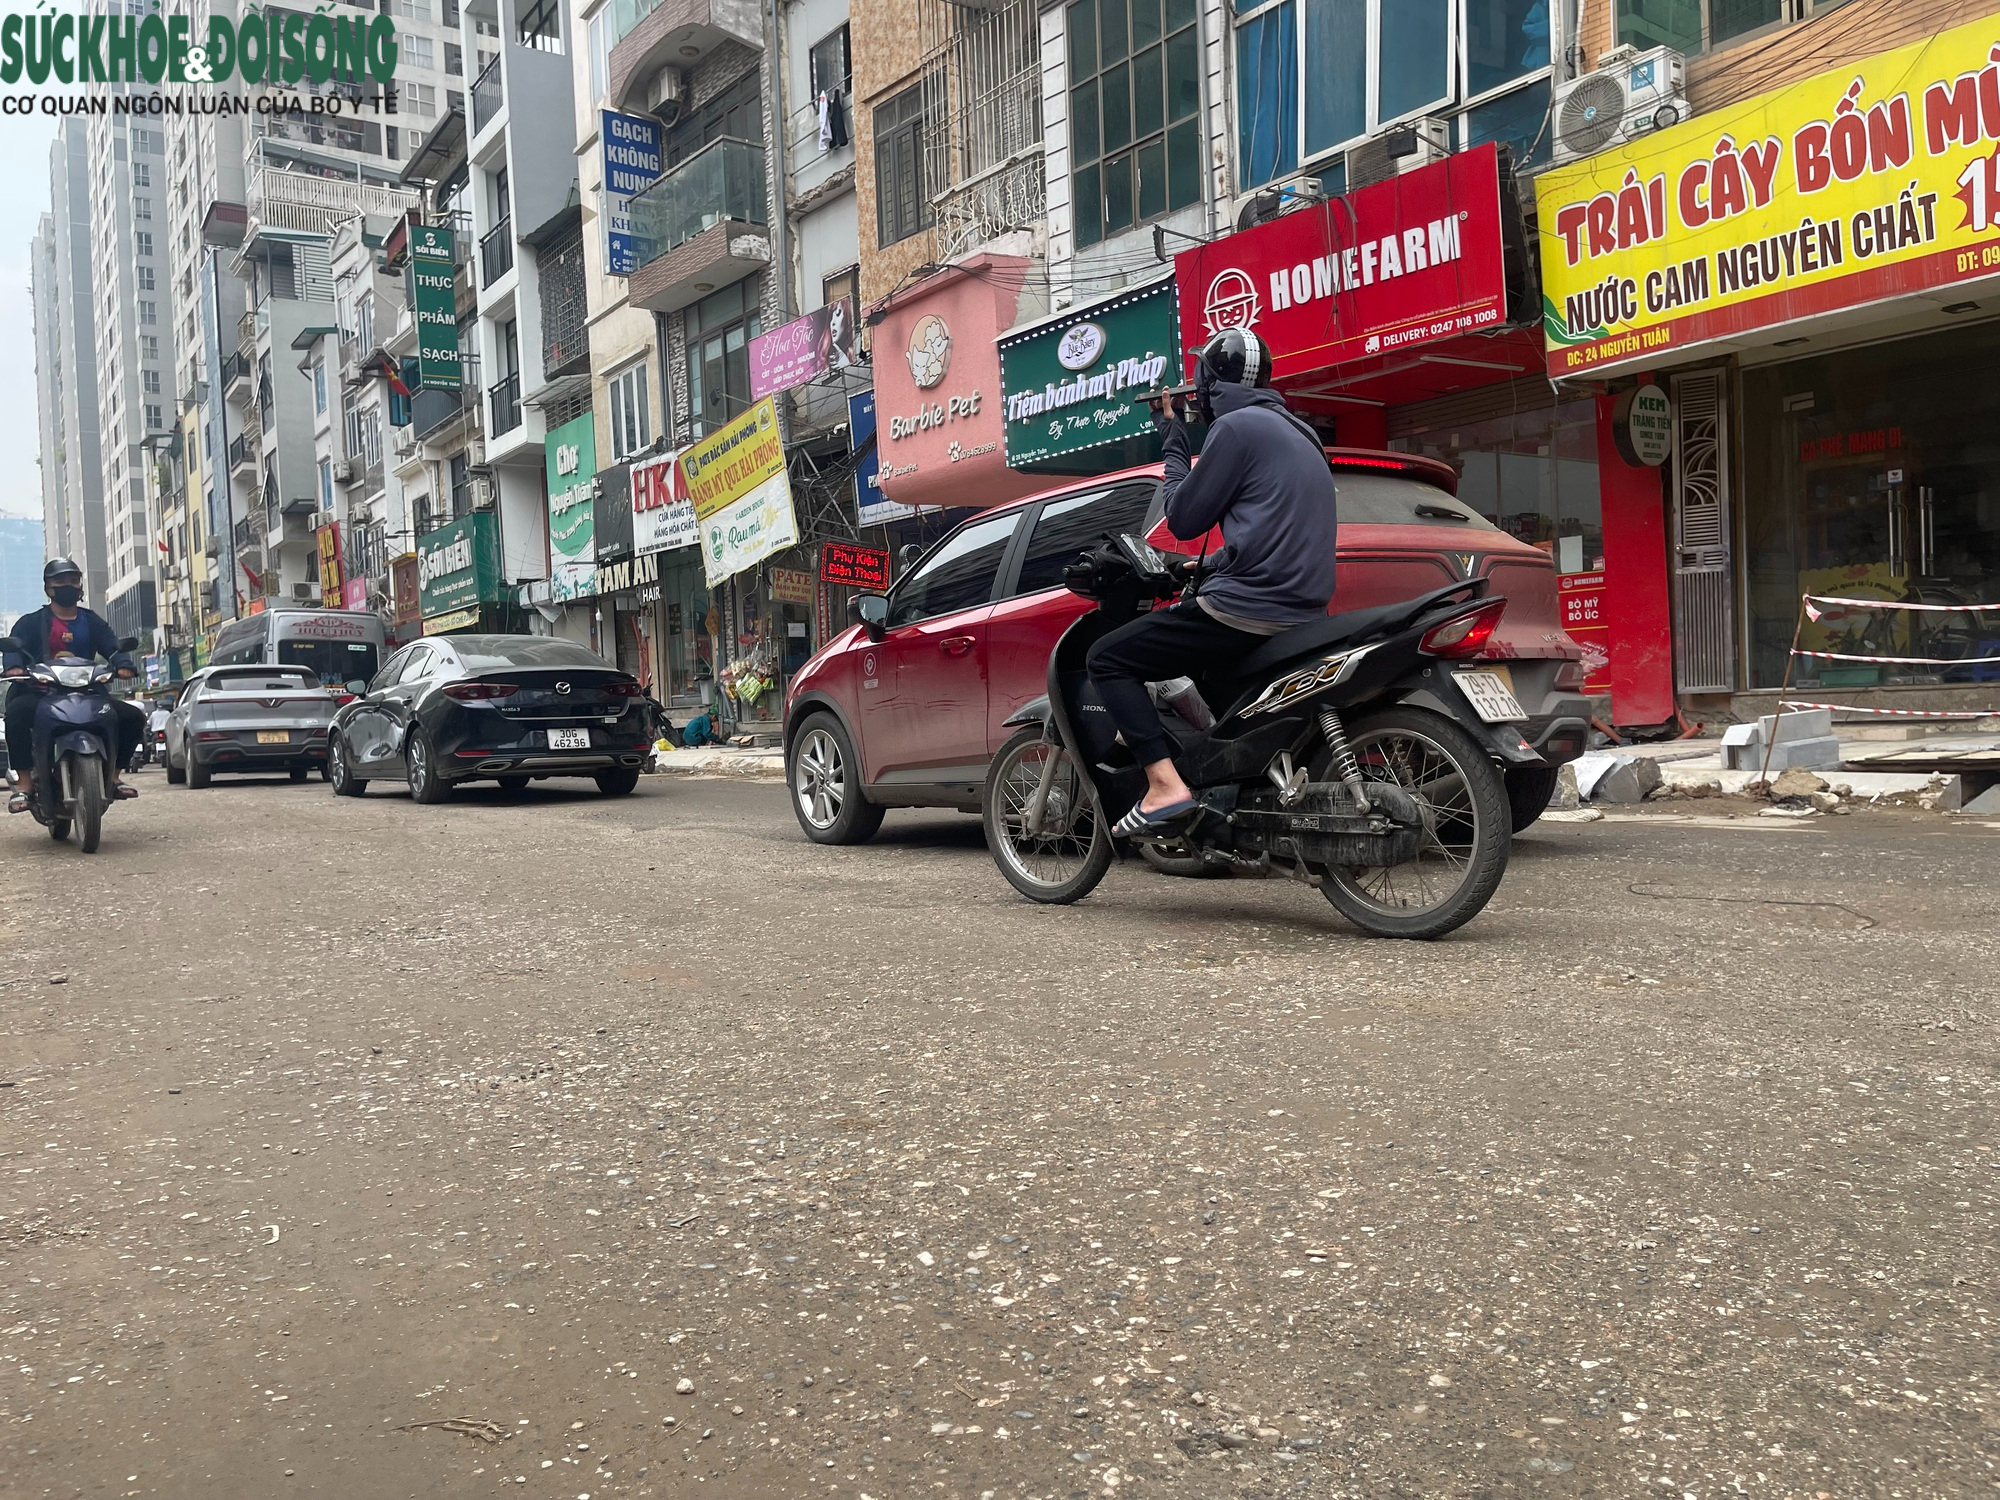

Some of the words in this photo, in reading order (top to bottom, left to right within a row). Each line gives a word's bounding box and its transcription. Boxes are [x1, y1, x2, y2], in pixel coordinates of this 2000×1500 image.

[612, 119, 652, 144] GẠCH
[607, 144, 659, 171] KHÔNG
[1557, 171, 1665, 266] TRÁI
[1679, 139, 1780, 227] CÂY
[1795, 81, 1910, 193] BỐN
[1270, 214, 1461, 312] HOMEFARM
[1566, 276, 1637, 335] NƯỚC
[1646, 258, 1709, 313] CAM
[1717, 218, 1843, 294] NGUYÊN
[1852, 181, 1937, 258] CHẤT
[1957, 253, 1979, 272] ĐT:
[416, 274, 452, 291] THỰC
[419, 307, 456, 325] PHẨM
[1383, 327, 1429, 346] DELIVERY:
[1430, 321, 1453, 335] 0247
[1455, 316, 1472, 329] 108
[1474, 309, 1497, 324] 1008
[422, 348, 458, 362] SẠCH
[761, 329, 791, 366] Hoa
[1567, 350, 1583, 366] ĐC:
[1586, 347, 1597, 362] 24
[1600, 335, 1640, 358] NGUYỄN
[1642, 327, 1670, 348] TUÂN
[1007, 389, 1047, 425] Tiệm
[1045, 373, 1089, 411] bánh
[1116, 351, 1168, 391] Pháp
[1639, 396, 1665, 412] KEM
[889, 402, 945, 441] Barbie
[947, 390, 983, 423] Pet
[1633, 413, 1655, 428] TRÀNG
[1048, 421, 1063, 440] By
[556, 443, 579, 476] Chợ
[699, 455, 710, 469] PATE
[691, 482, 714, 508] BÁNH
[723, 463, 741, 492] QUE
[739, 448, 755, 480] HẢI
[753, 436, 780, 470] PHÒNG
[428, 542, 446, 580] SÓI
[833, 549, 854, 564] Phụ
[856, 552, 879, 567] Kiện
[633, 553, 658, 586] AN
[776, 570, 812, 586] PATE
[828, 563, 852, 577] Điện
[854, 566, 881, 582] Thoại
[1574, 576, 1604, 586] HOMEFARM
[642, 586, 661, 603] HAIR
[1568, 598, 1581, 610] BÒ
[1584, 596, 1599, 608] MỸ
[1568, 610, 1582, 621] BÒ
[1584, 609, 1599, 620] ÚC
[1461, 674, 1505, 695] 29-T2
[1475, 696, 1523, 718] 132.28
[560, 729, 577, 738] 30G
[554, 739, 586, 748] 462.96
